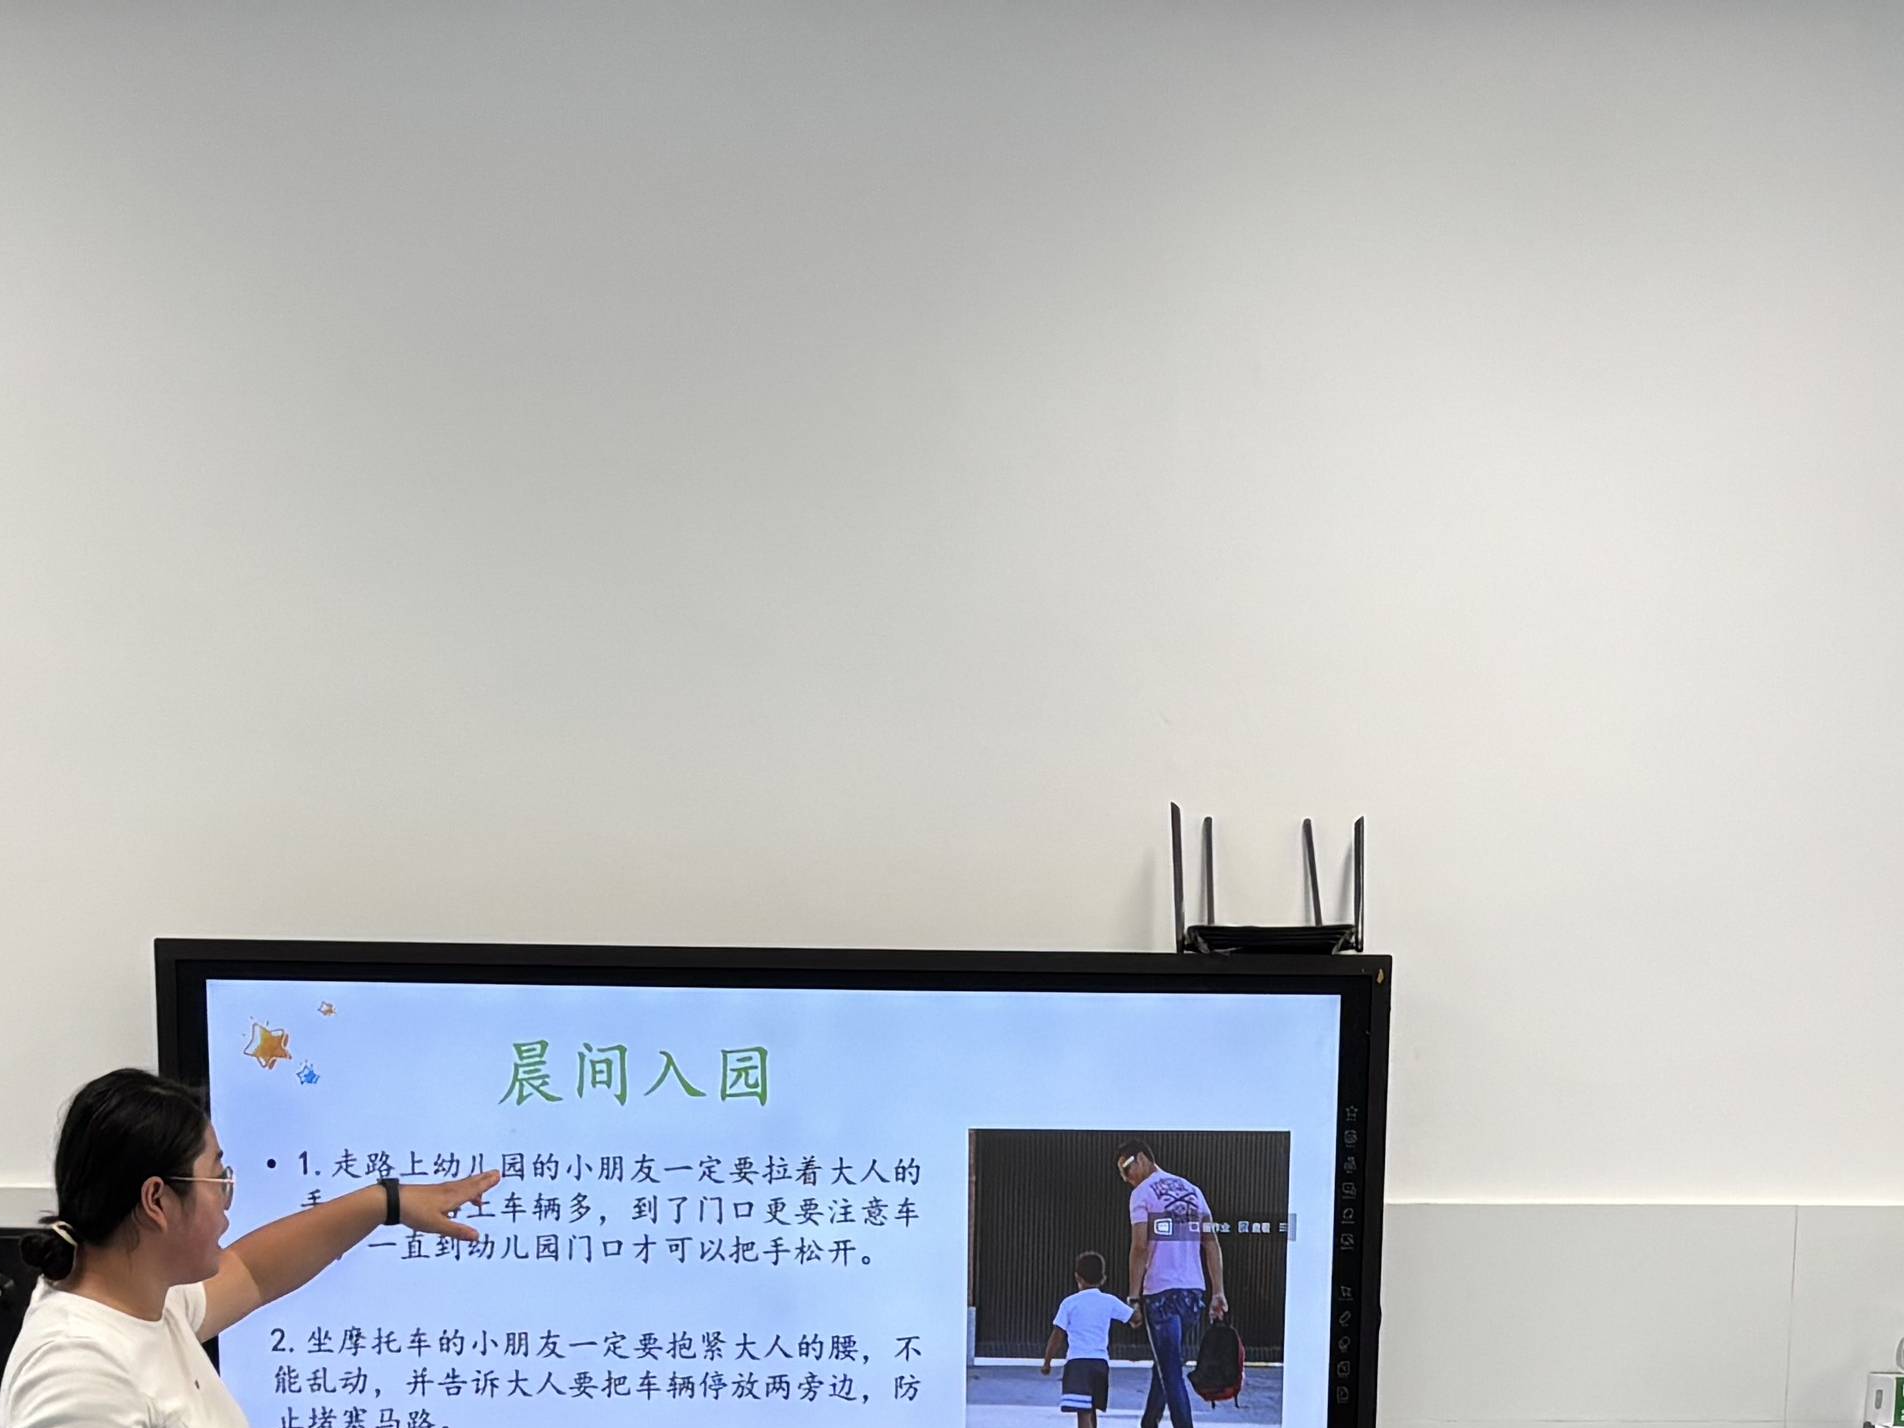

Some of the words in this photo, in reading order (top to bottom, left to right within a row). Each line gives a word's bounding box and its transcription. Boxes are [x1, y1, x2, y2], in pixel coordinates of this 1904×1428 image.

[498, 1039, 768, 1106] 晨间入园
[274, 1364, 922, 1404] 能乱动，并告诉大人要把车辆停放两旁边，防
